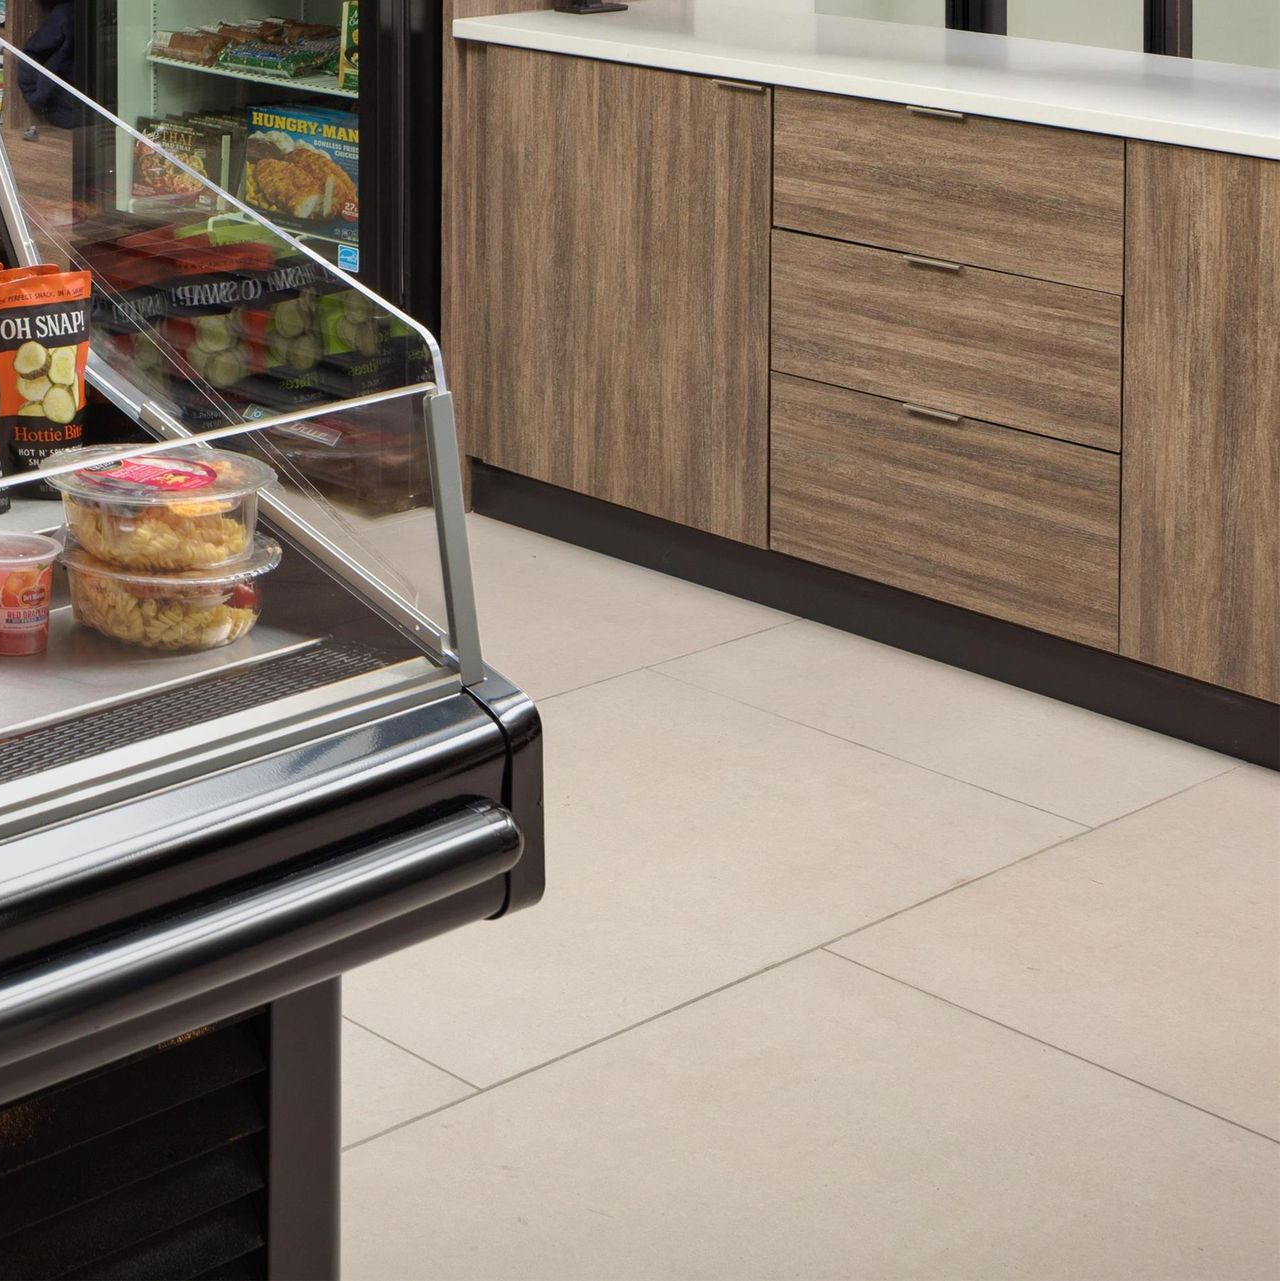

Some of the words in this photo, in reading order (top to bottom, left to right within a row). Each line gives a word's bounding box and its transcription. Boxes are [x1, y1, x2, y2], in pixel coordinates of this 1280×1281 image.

[252, 111, 359, 144] HUNGRY-MAN
[162, 131, 194, 145] THAI
[313, 139, 342, 150] BONELESS
[7, 293, 32, 304] PERFECT
[34, 290, 56, 300] SNACK,
[0, 318, 33, 341] OH
[35, 309, 85, 339] SNAP!
[15, 425, 62, 442] Hottie
[18, 448, 35, 457] HOT
[39, 448, 48, 457] N'
[7, 610, 21, 619] RED
